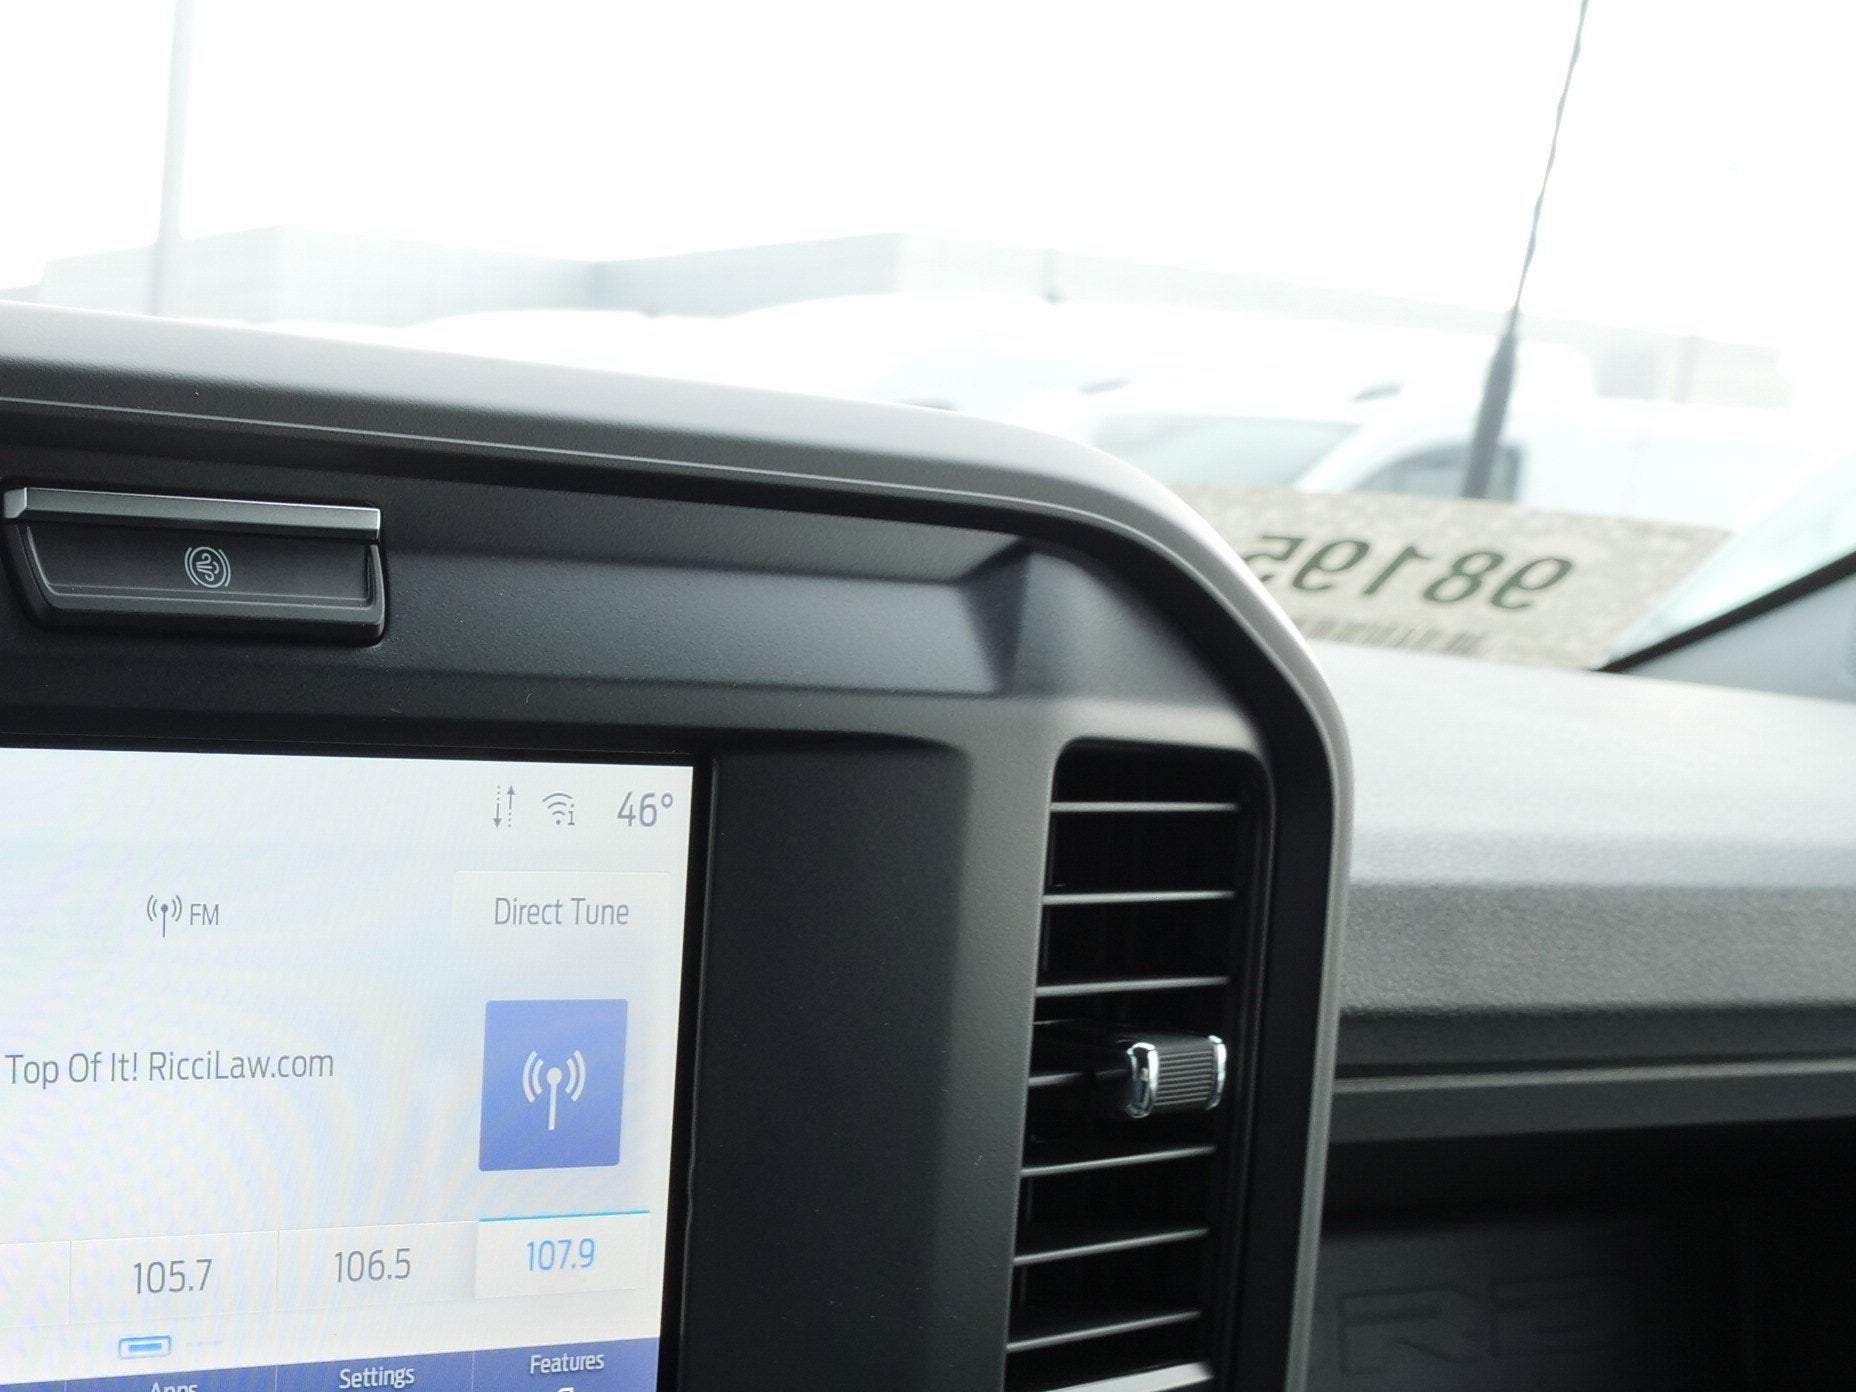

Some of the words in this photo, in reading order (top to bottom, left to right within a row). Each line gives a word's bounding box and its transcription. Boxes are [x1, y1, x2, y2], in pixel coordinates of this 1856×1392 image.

[617, 792, 673, 827] 46°
[190, 904, 219, 925] FM
[495, 898, 562, 925] Direct
[571, 898, 628, 925] Tune
[5, 1055, 59, 1089] Top
[69, 1052, 101, 1082] Of
[112, 1052, 137, 1081] It!
[150, 1051, 333, 1080] RicciLaw.com
[335, 1248, 410, 1282] 106.5
[528, 1238, 594, 1270] 107.9
[134, 1259, 212, 1294] 105.7
[339, 1364, 416, 1389] Settings
[530, 1351, 605, 1374] Features
